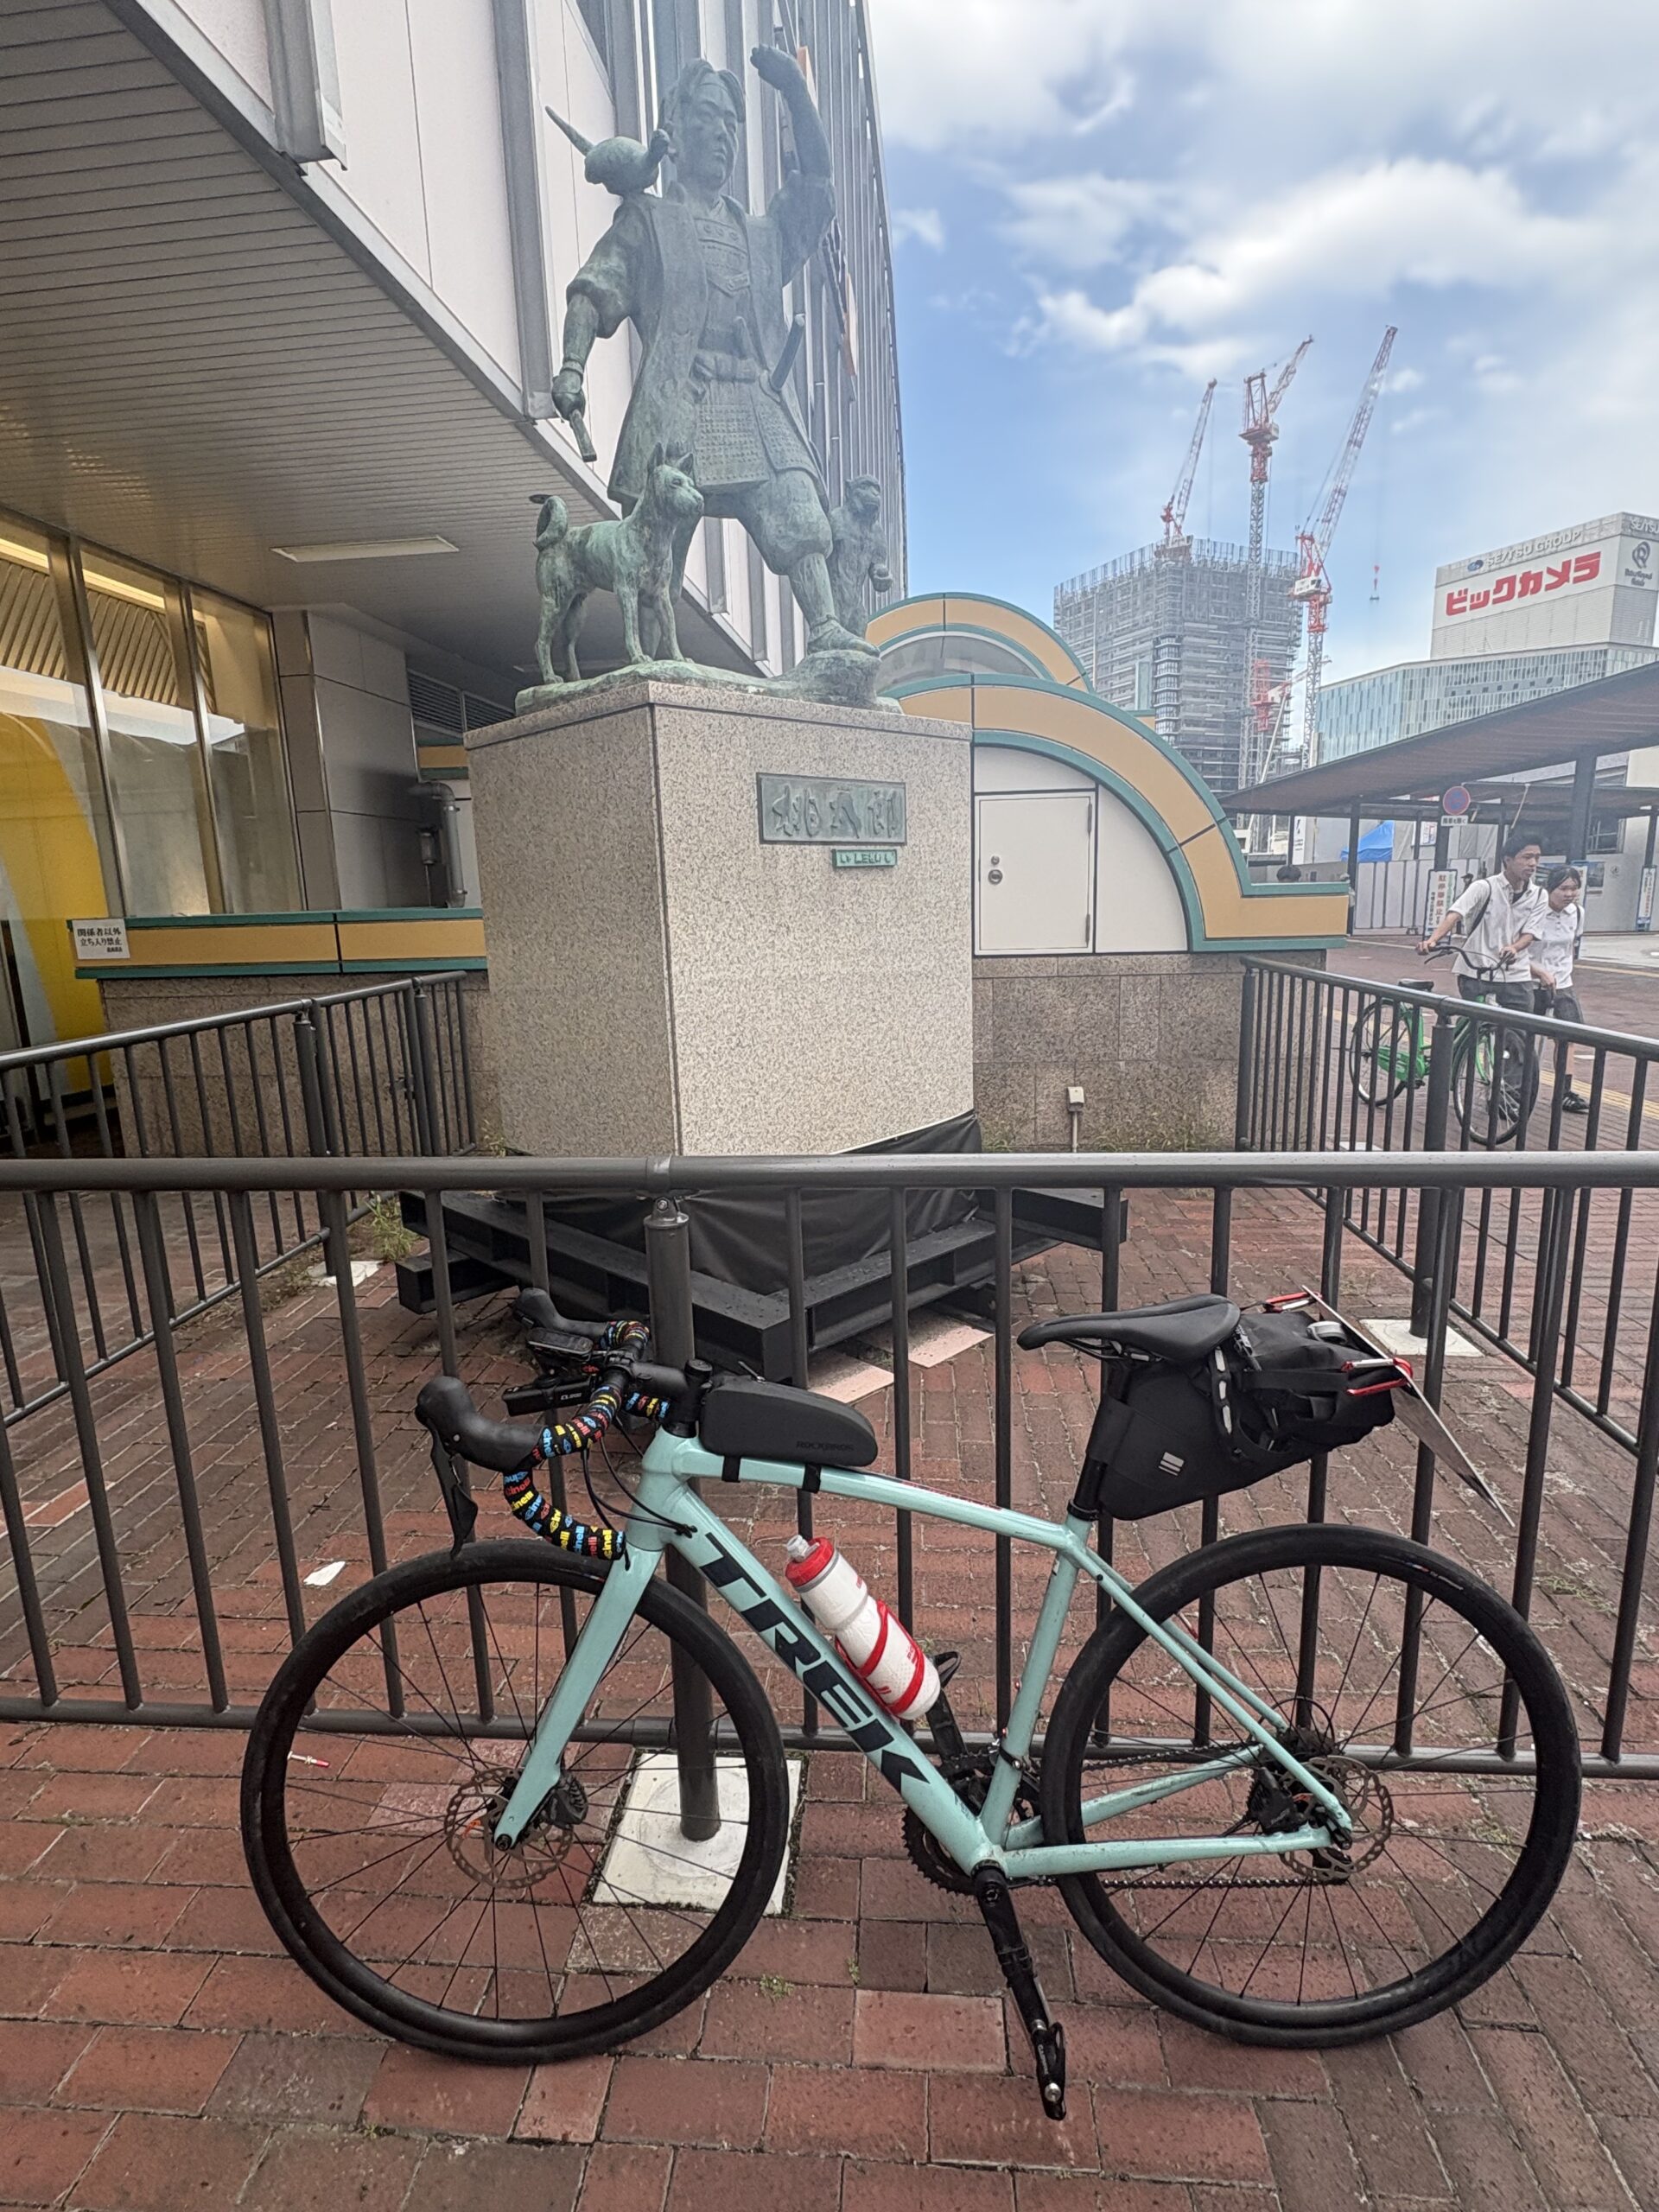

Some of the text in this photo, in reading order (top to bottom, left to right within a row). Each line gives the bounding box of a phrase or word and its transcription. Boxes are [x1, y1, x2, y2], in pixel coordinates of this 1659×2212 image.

[1535, 529, 1582, 552] GROUP
[1446, 551, 1602, 616] ビックカメラ
[77, 927, 122, 937] 関係者以外
[80, 937, 123, 946] 立ち入り禁止
[701, 1532, 930, 1793] TREK
